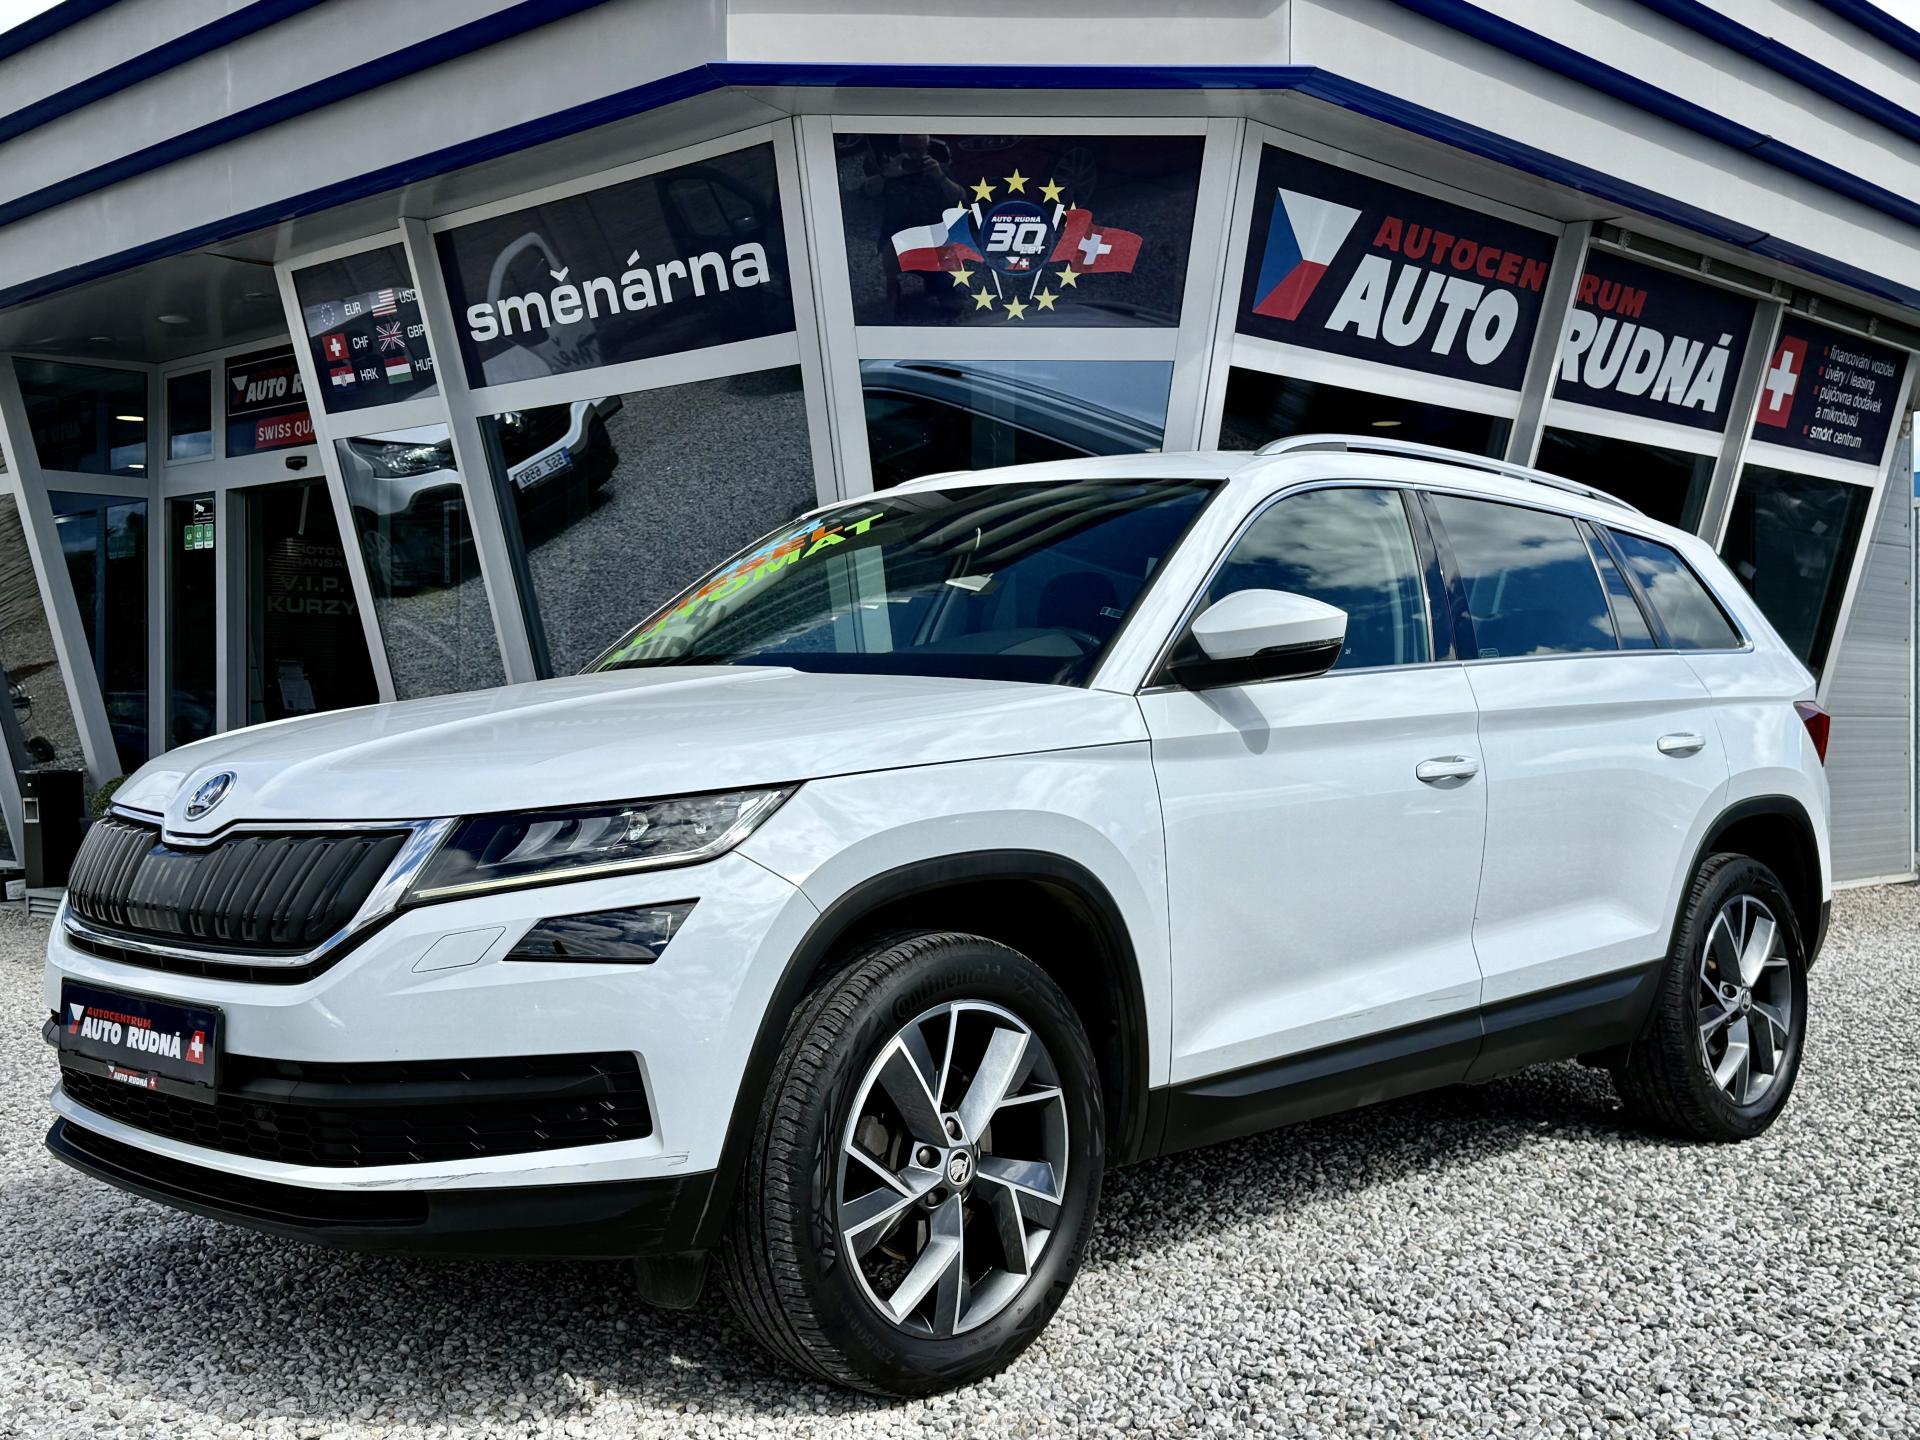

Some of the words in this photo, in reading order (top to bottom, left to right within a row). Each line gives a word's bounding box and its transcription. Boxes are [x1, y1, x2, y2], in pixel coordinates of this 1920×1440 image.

[986, 223, 1048, 252] 30
[1372, 215, 1548, 292] AUTOCEN
[344, 302, 362, 316] EUR
[399, 289, 418, 303] USD
[466, 241, 771, 342] směnárna
[352, 335, 369, 350] CHF
[407, 323, 425, 338] GBP
[1324, 253, 1519, 365] AUTO
[1560, 309, 1734, 413] RUDNÁ
[360, 367, 379, 381] HRK
[415, 357, 434, 372] HUF
[245, 375, 288, 403] AUTO
[1850, 372, 1876, 395] leasing
[1815, 406, 1821, 419] a
[258, 422, 291, 441] SWISS
[1833, 431, 1863, 449] centrum
[265, 595, 354, 615] KURZY
[87, 1006, 152, 1028] AUTOCENTRUM
[80, 1016, 122, 1045] AUTO
[126, 1025, 181, 1060] RUDNÁ
[113, 1071, 128, 1082] AUTO
